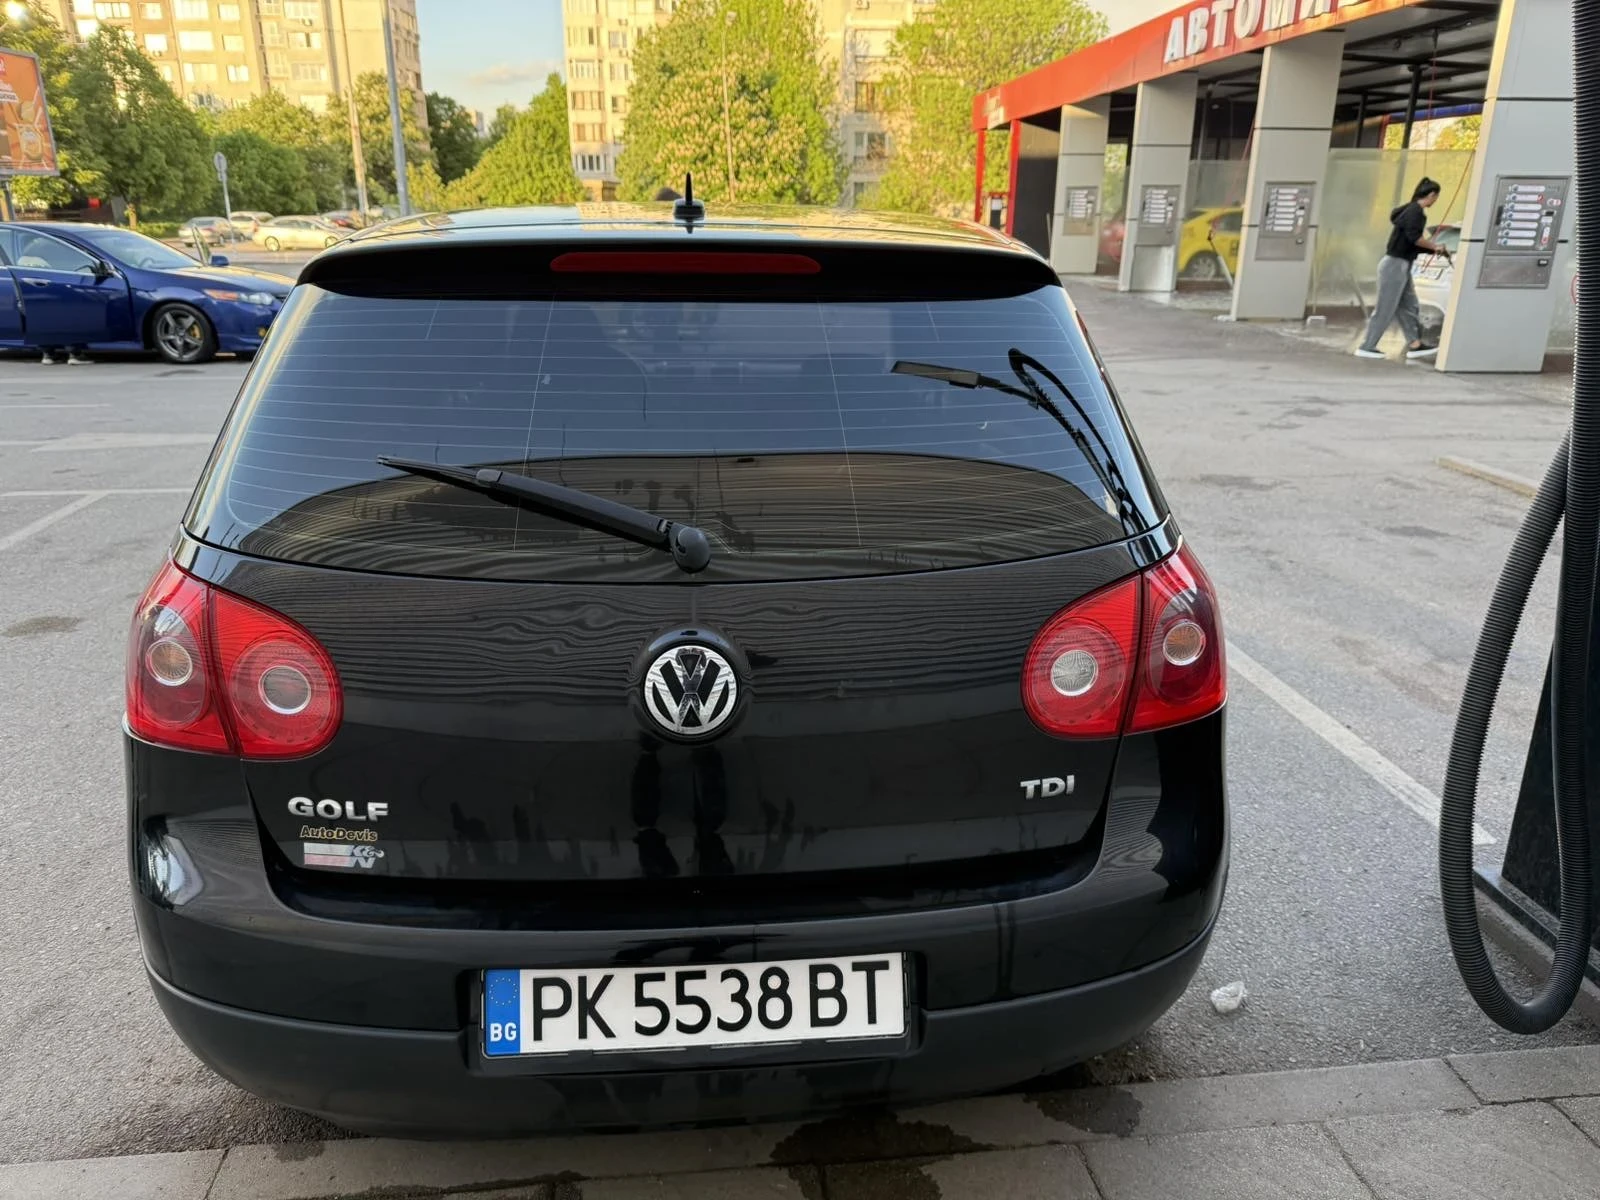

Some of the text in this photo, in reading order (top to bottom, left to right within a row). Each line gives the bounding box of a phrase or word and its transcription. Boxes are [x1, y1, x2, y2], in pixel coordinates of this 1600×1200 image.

[1164, 0, 1367, 63] АВТОМ
[1020, 774, 1075, 800] TDI
[287, 796, 389, 821] GOLF
[299, 825, 378, 842] AutoDevis
[532, 960, 890, 1042] PK 5538 BT
[489, 1023, 518, 1042] BG
